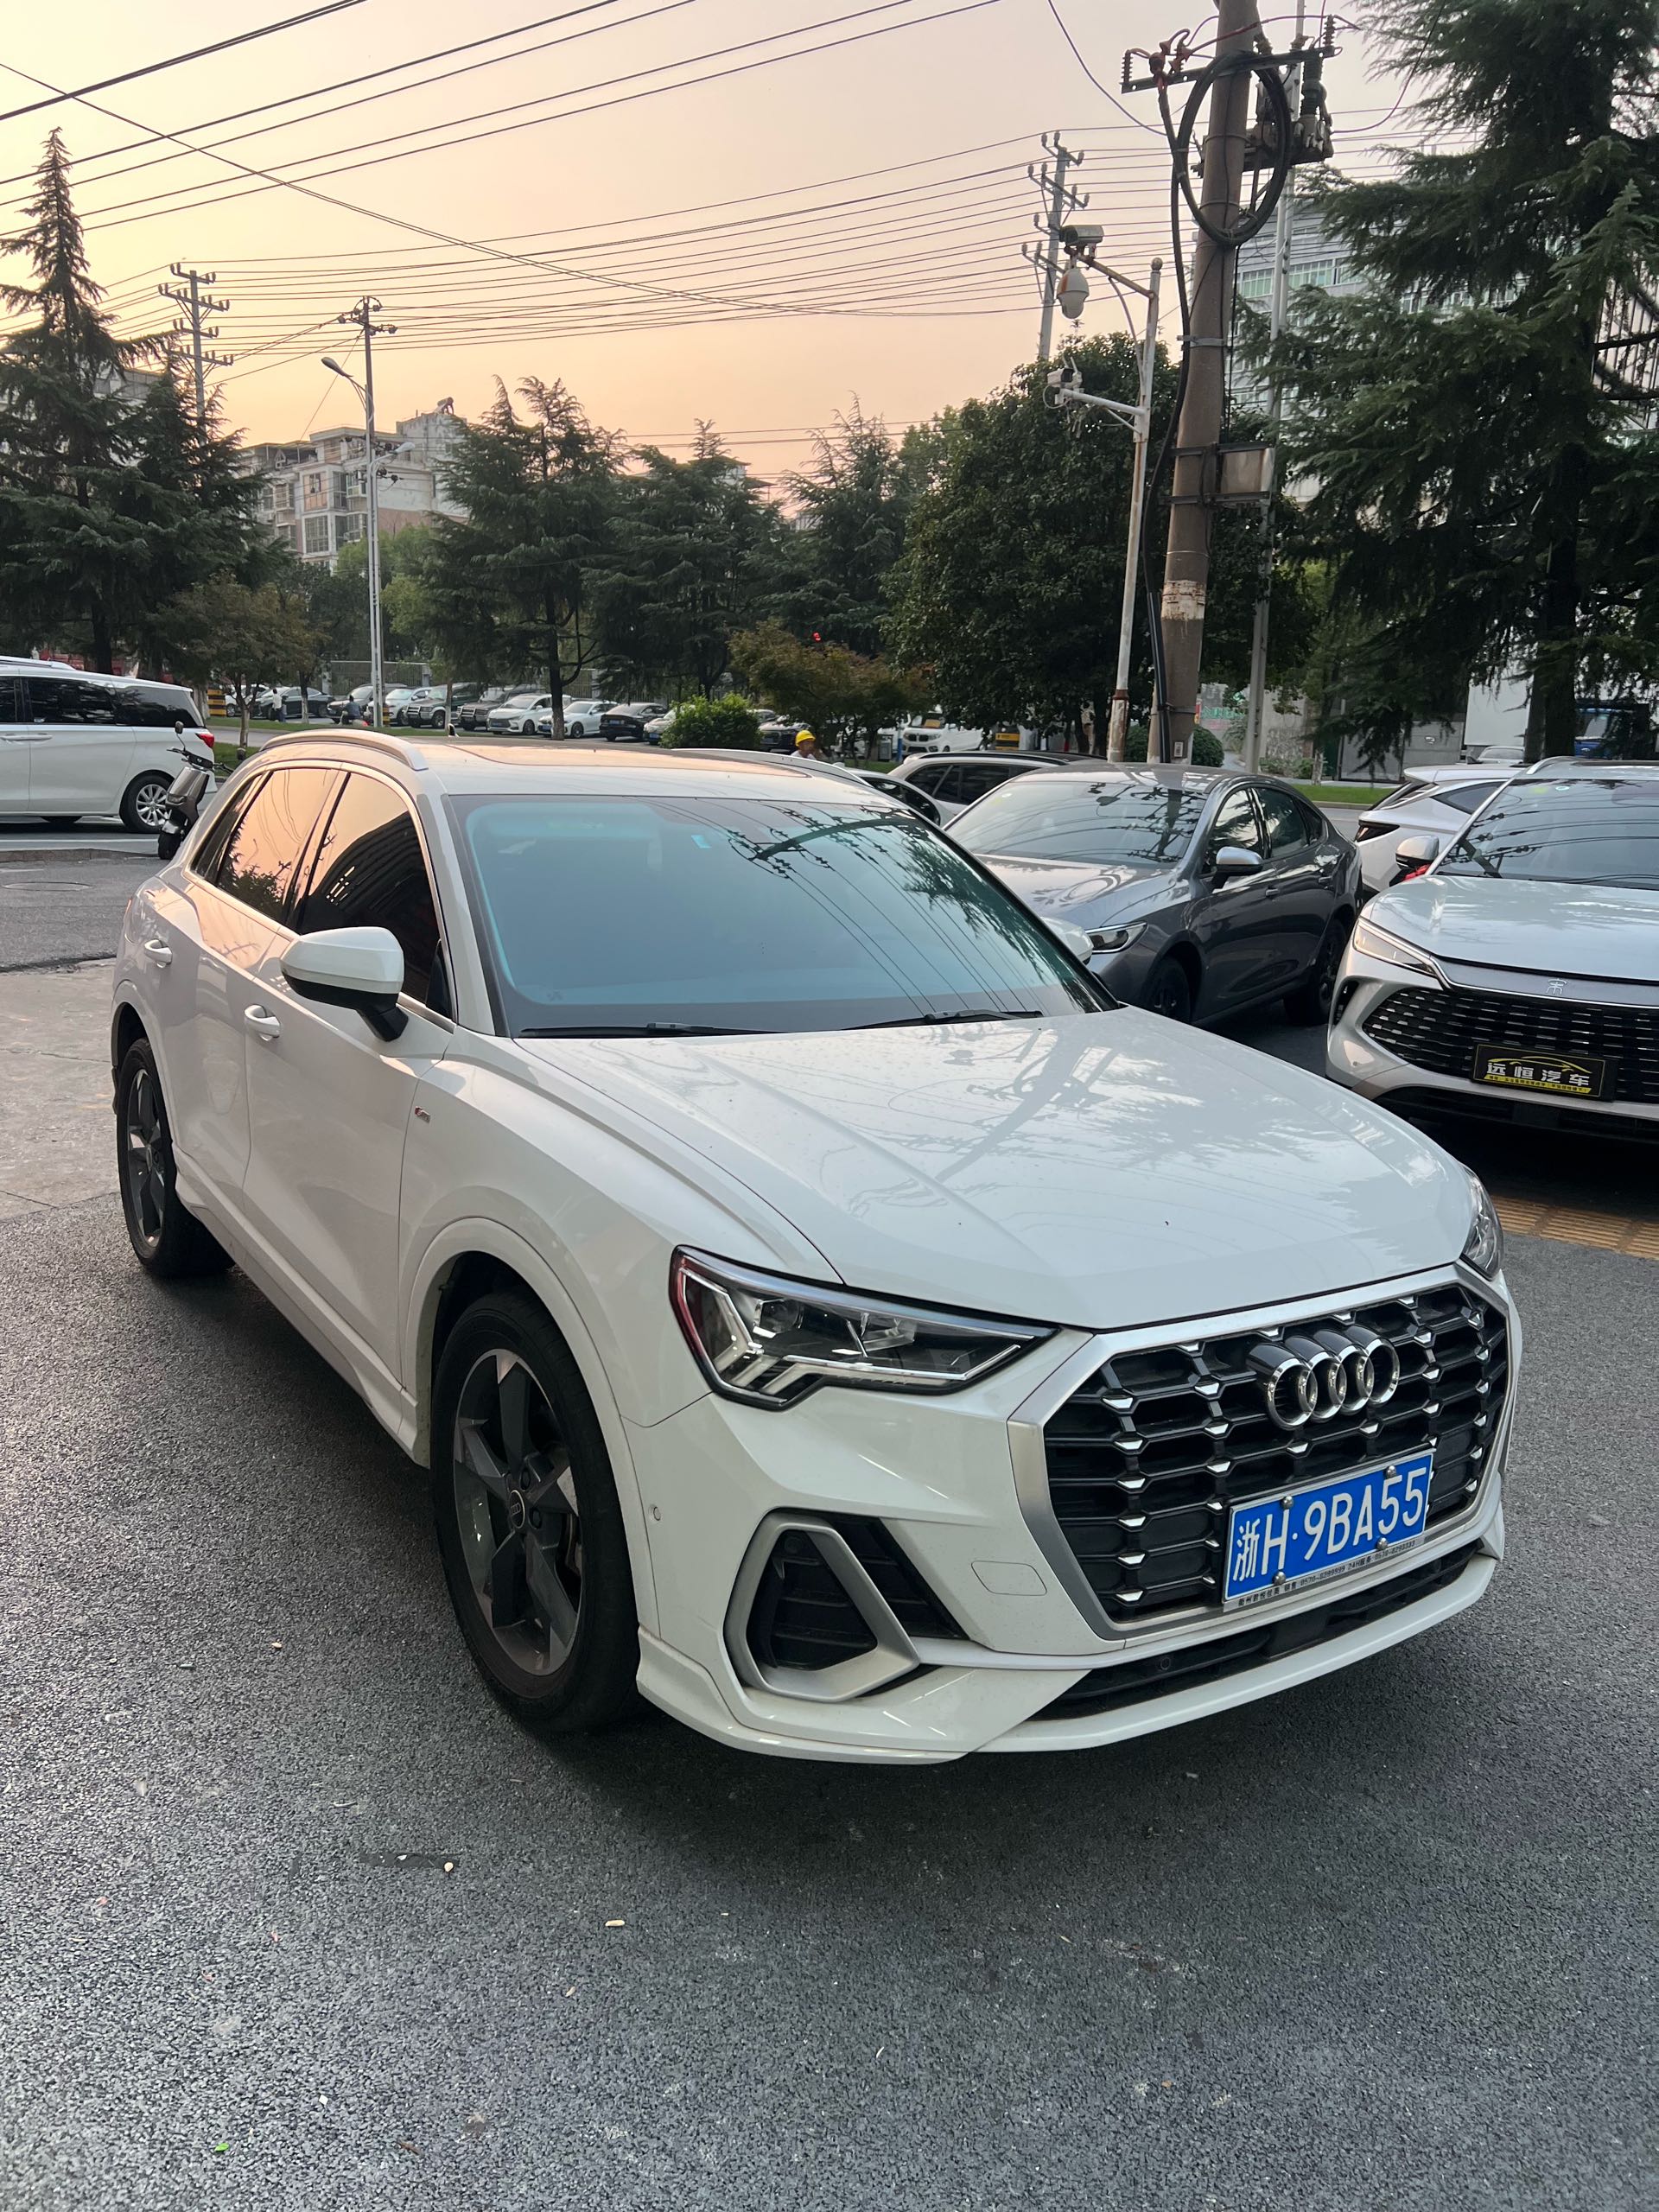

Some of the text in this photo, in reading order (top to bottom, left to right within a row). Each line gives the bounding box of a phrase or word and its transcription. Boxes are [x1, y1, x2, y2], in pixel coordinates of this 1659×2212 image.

[1487, 1063, 1590, 1086] 远恒汽车
[1233, 1467, 1427, 1581] 浙H·9BA55
